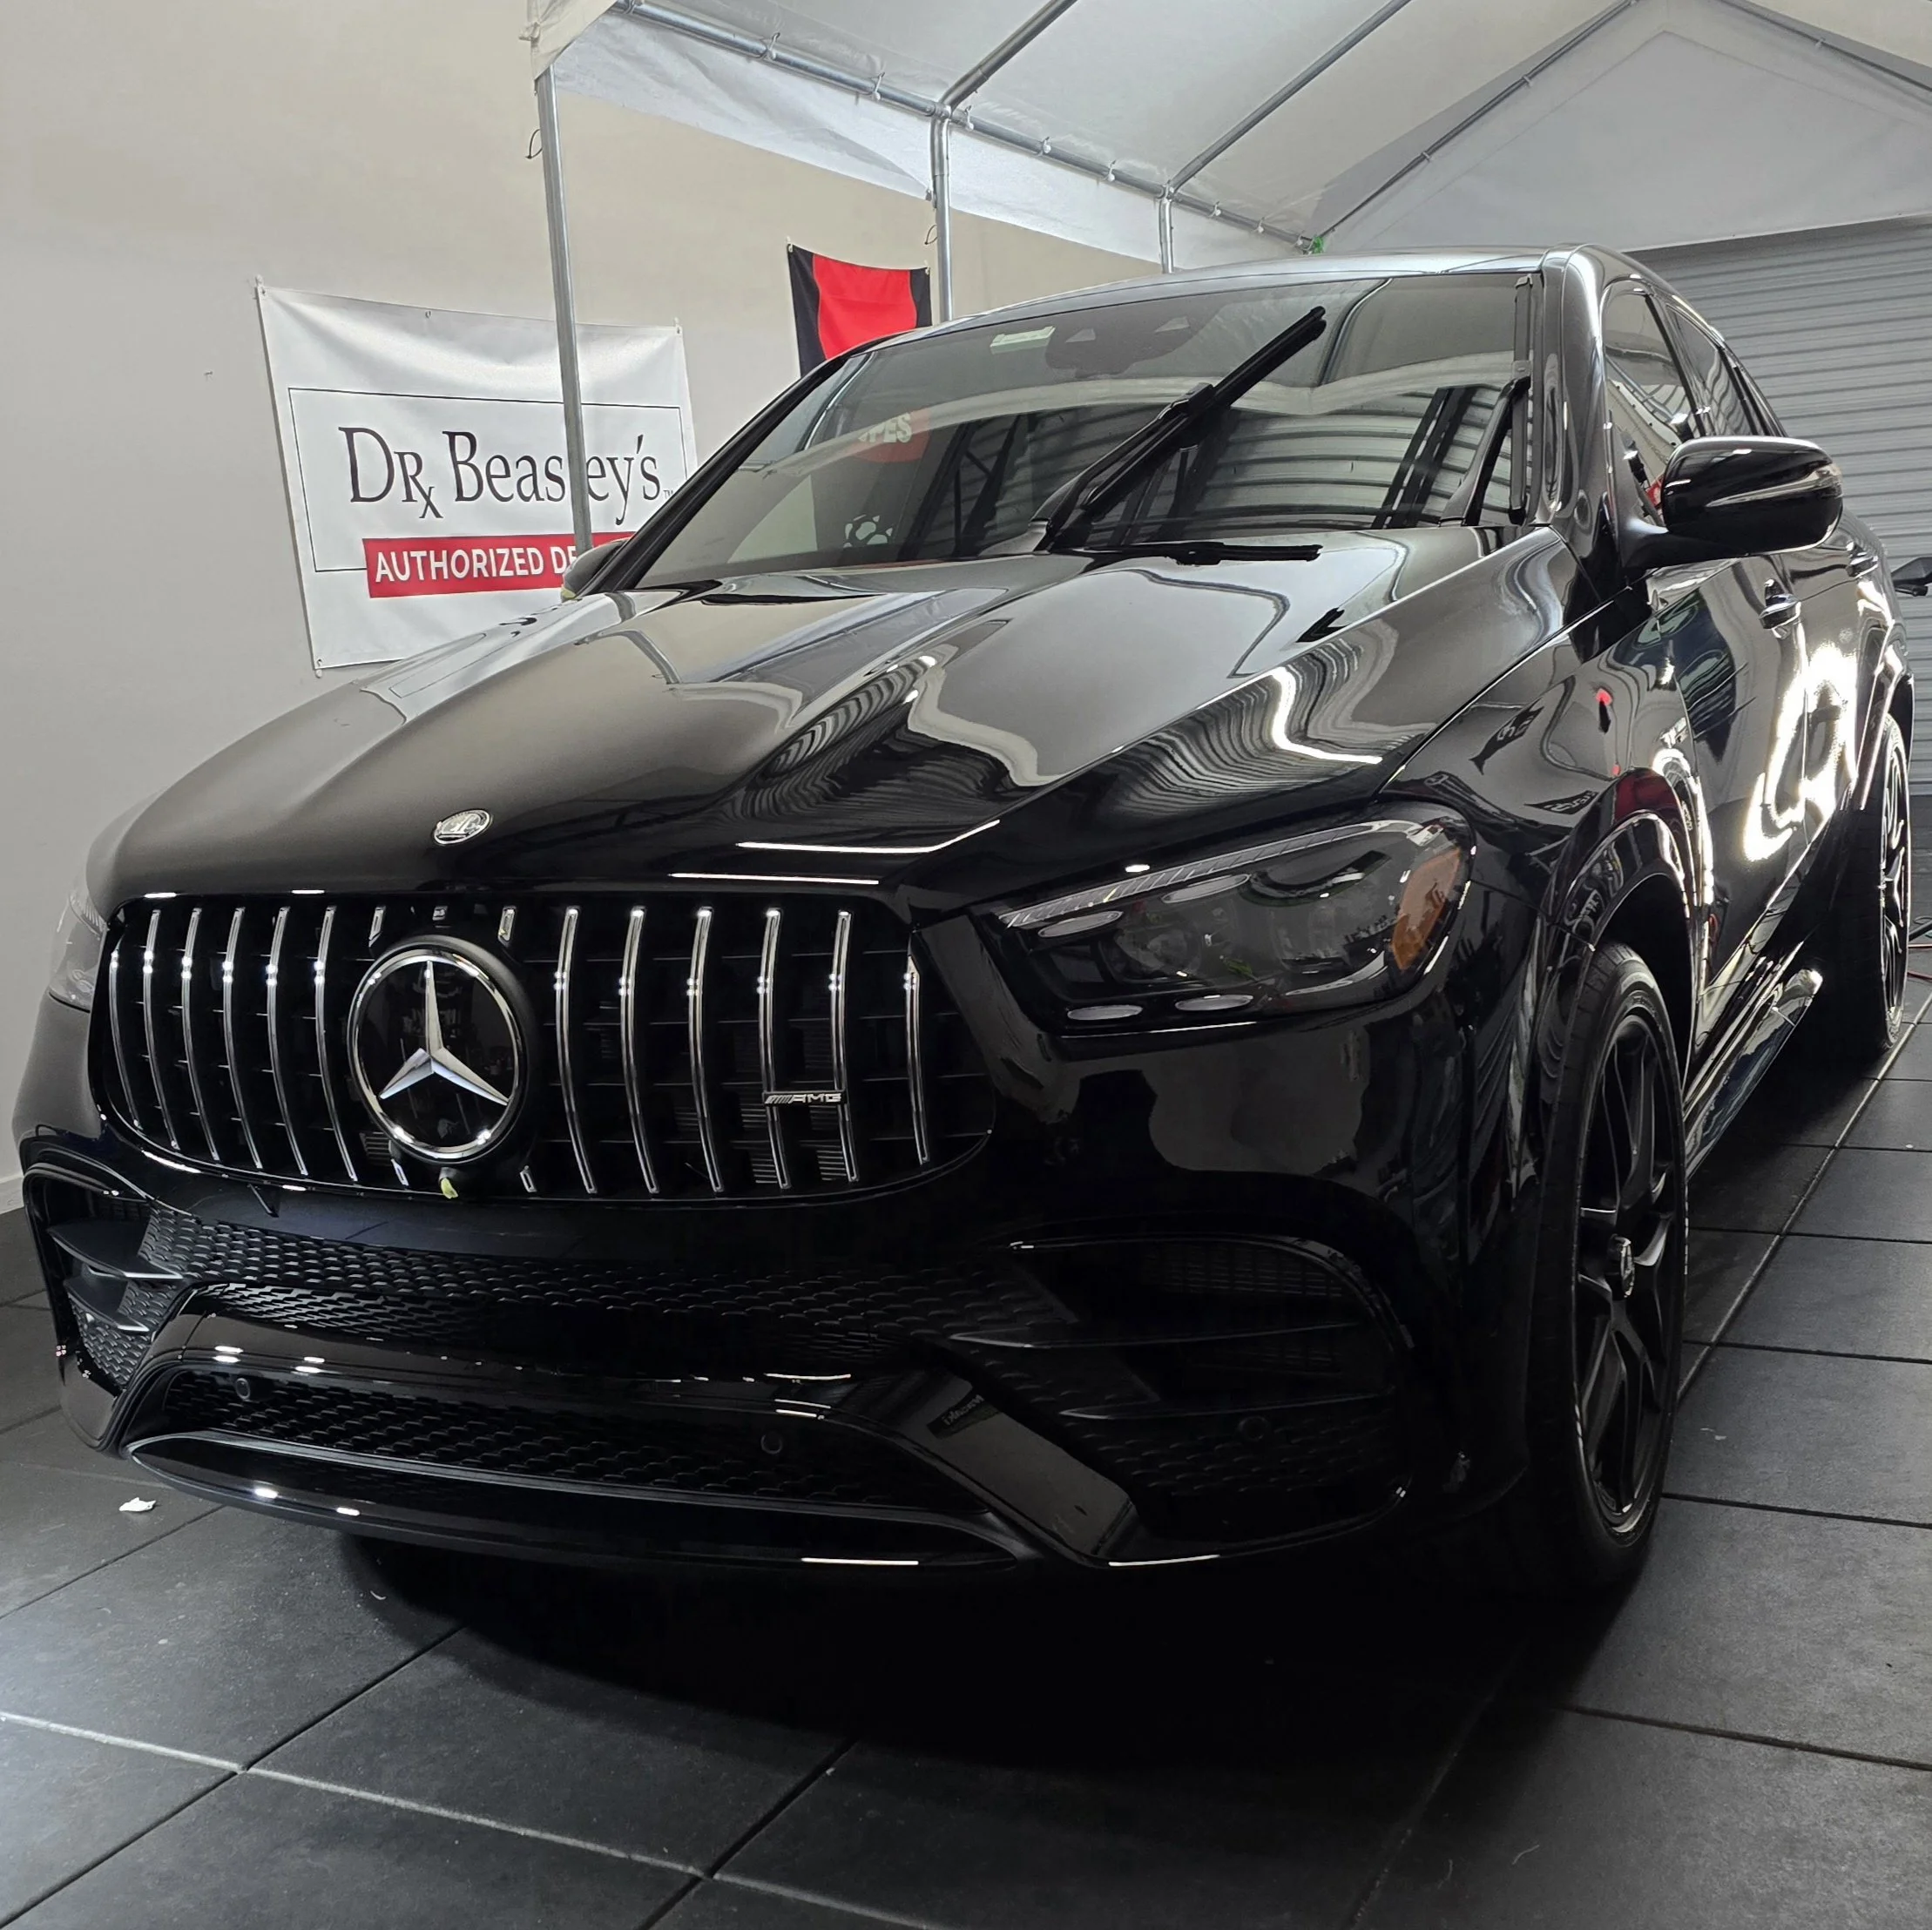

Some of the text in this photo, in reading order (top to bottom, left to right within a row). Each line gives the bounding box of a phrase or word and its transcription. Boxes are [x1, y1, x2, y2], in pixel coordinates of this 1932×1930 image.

[442, 430, 660, 525] Beasey's
[375, 547, 544, 583] AUTHORIZED
[787, 1092, 842, 1104] AMG
